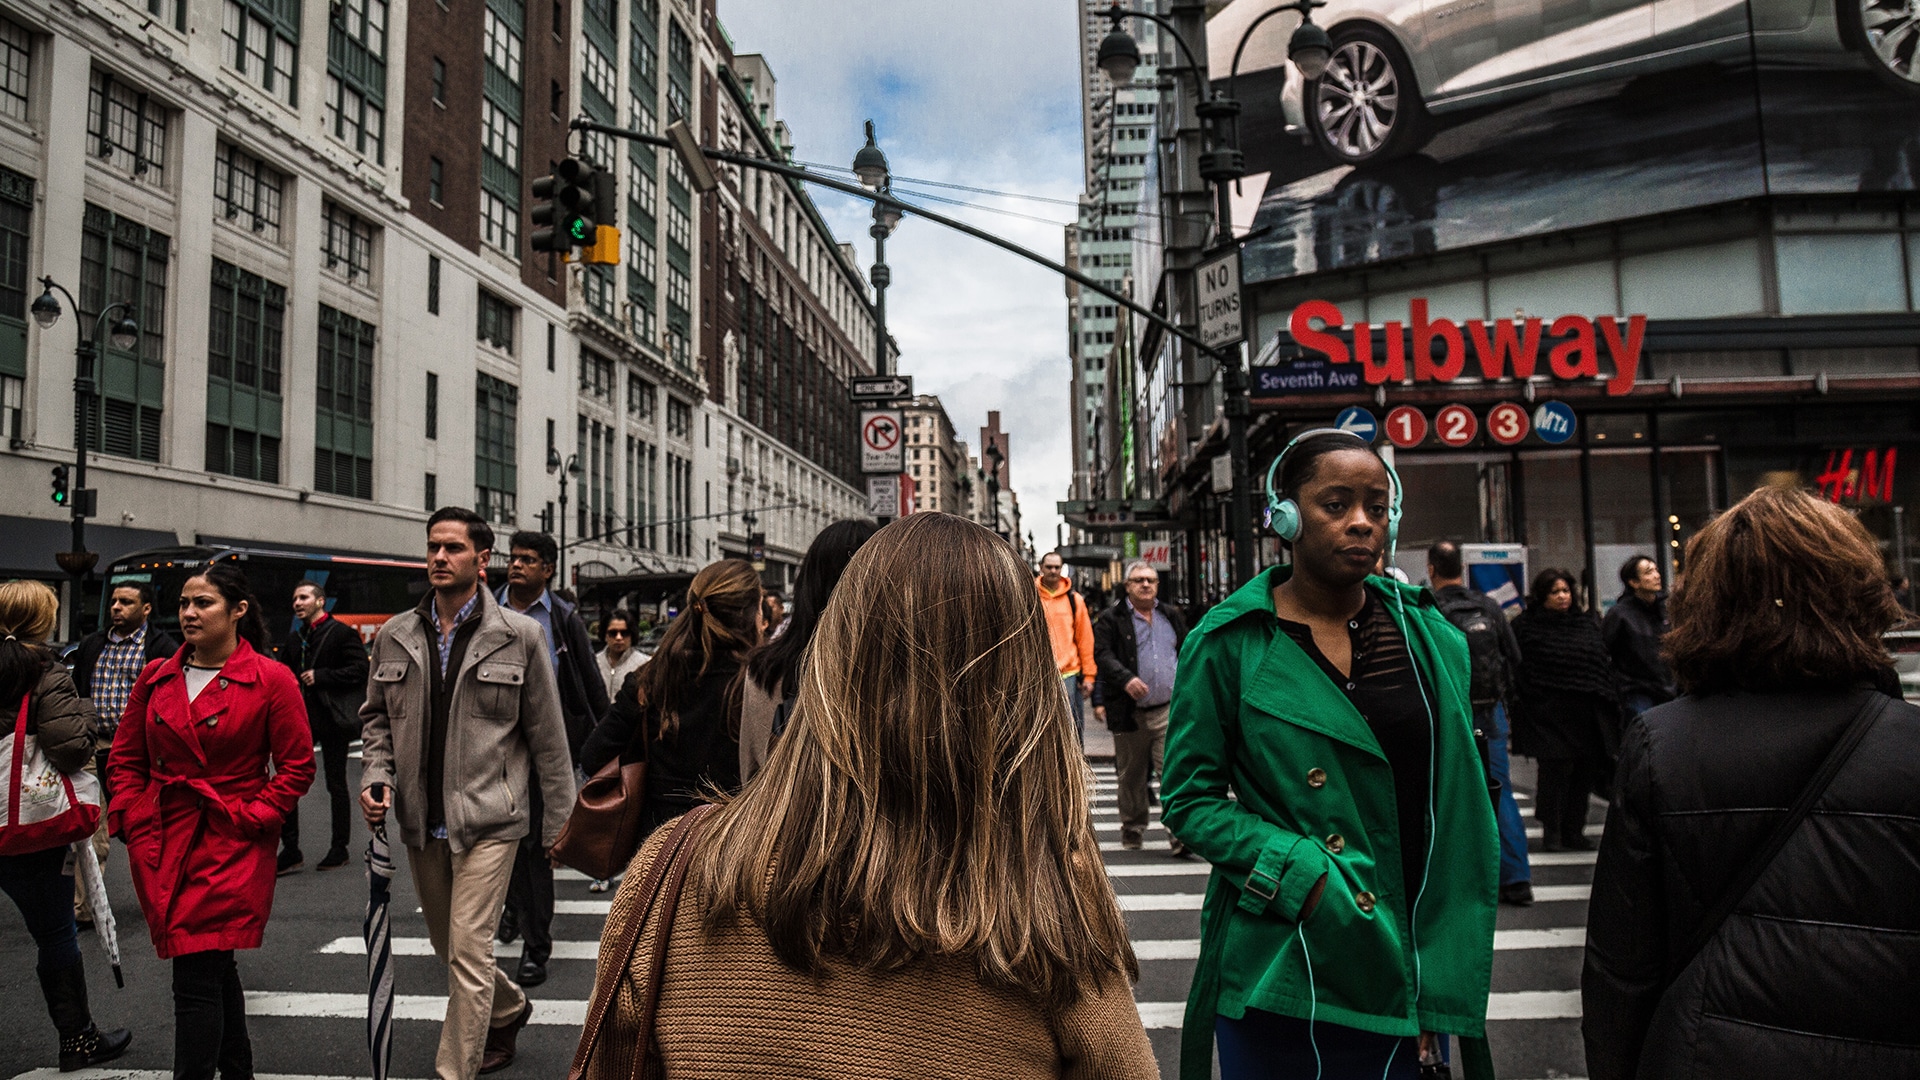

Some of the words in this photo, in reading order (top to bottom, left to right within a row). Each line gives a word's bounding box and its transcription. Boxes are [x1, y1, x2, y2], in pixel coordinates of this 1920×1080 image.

[1206, 264, 1229, 293] NO
[1200, 292, 1240, 323] TURNS
[1288, 298, 1647, 396] Subway
[860, 383, 876, 392] ONE
[884, 382, 901, 392] WAY
[1260, 371, 1324, 389] Seventh
[1328, 370, 1359, 386] Ave
[1397, 413, 1412, 441] 1
[1446, 411, 1468, 440] 2
[1497, 409, 1519, 438] 3
[1816, 447, 1898, 504] H&M
